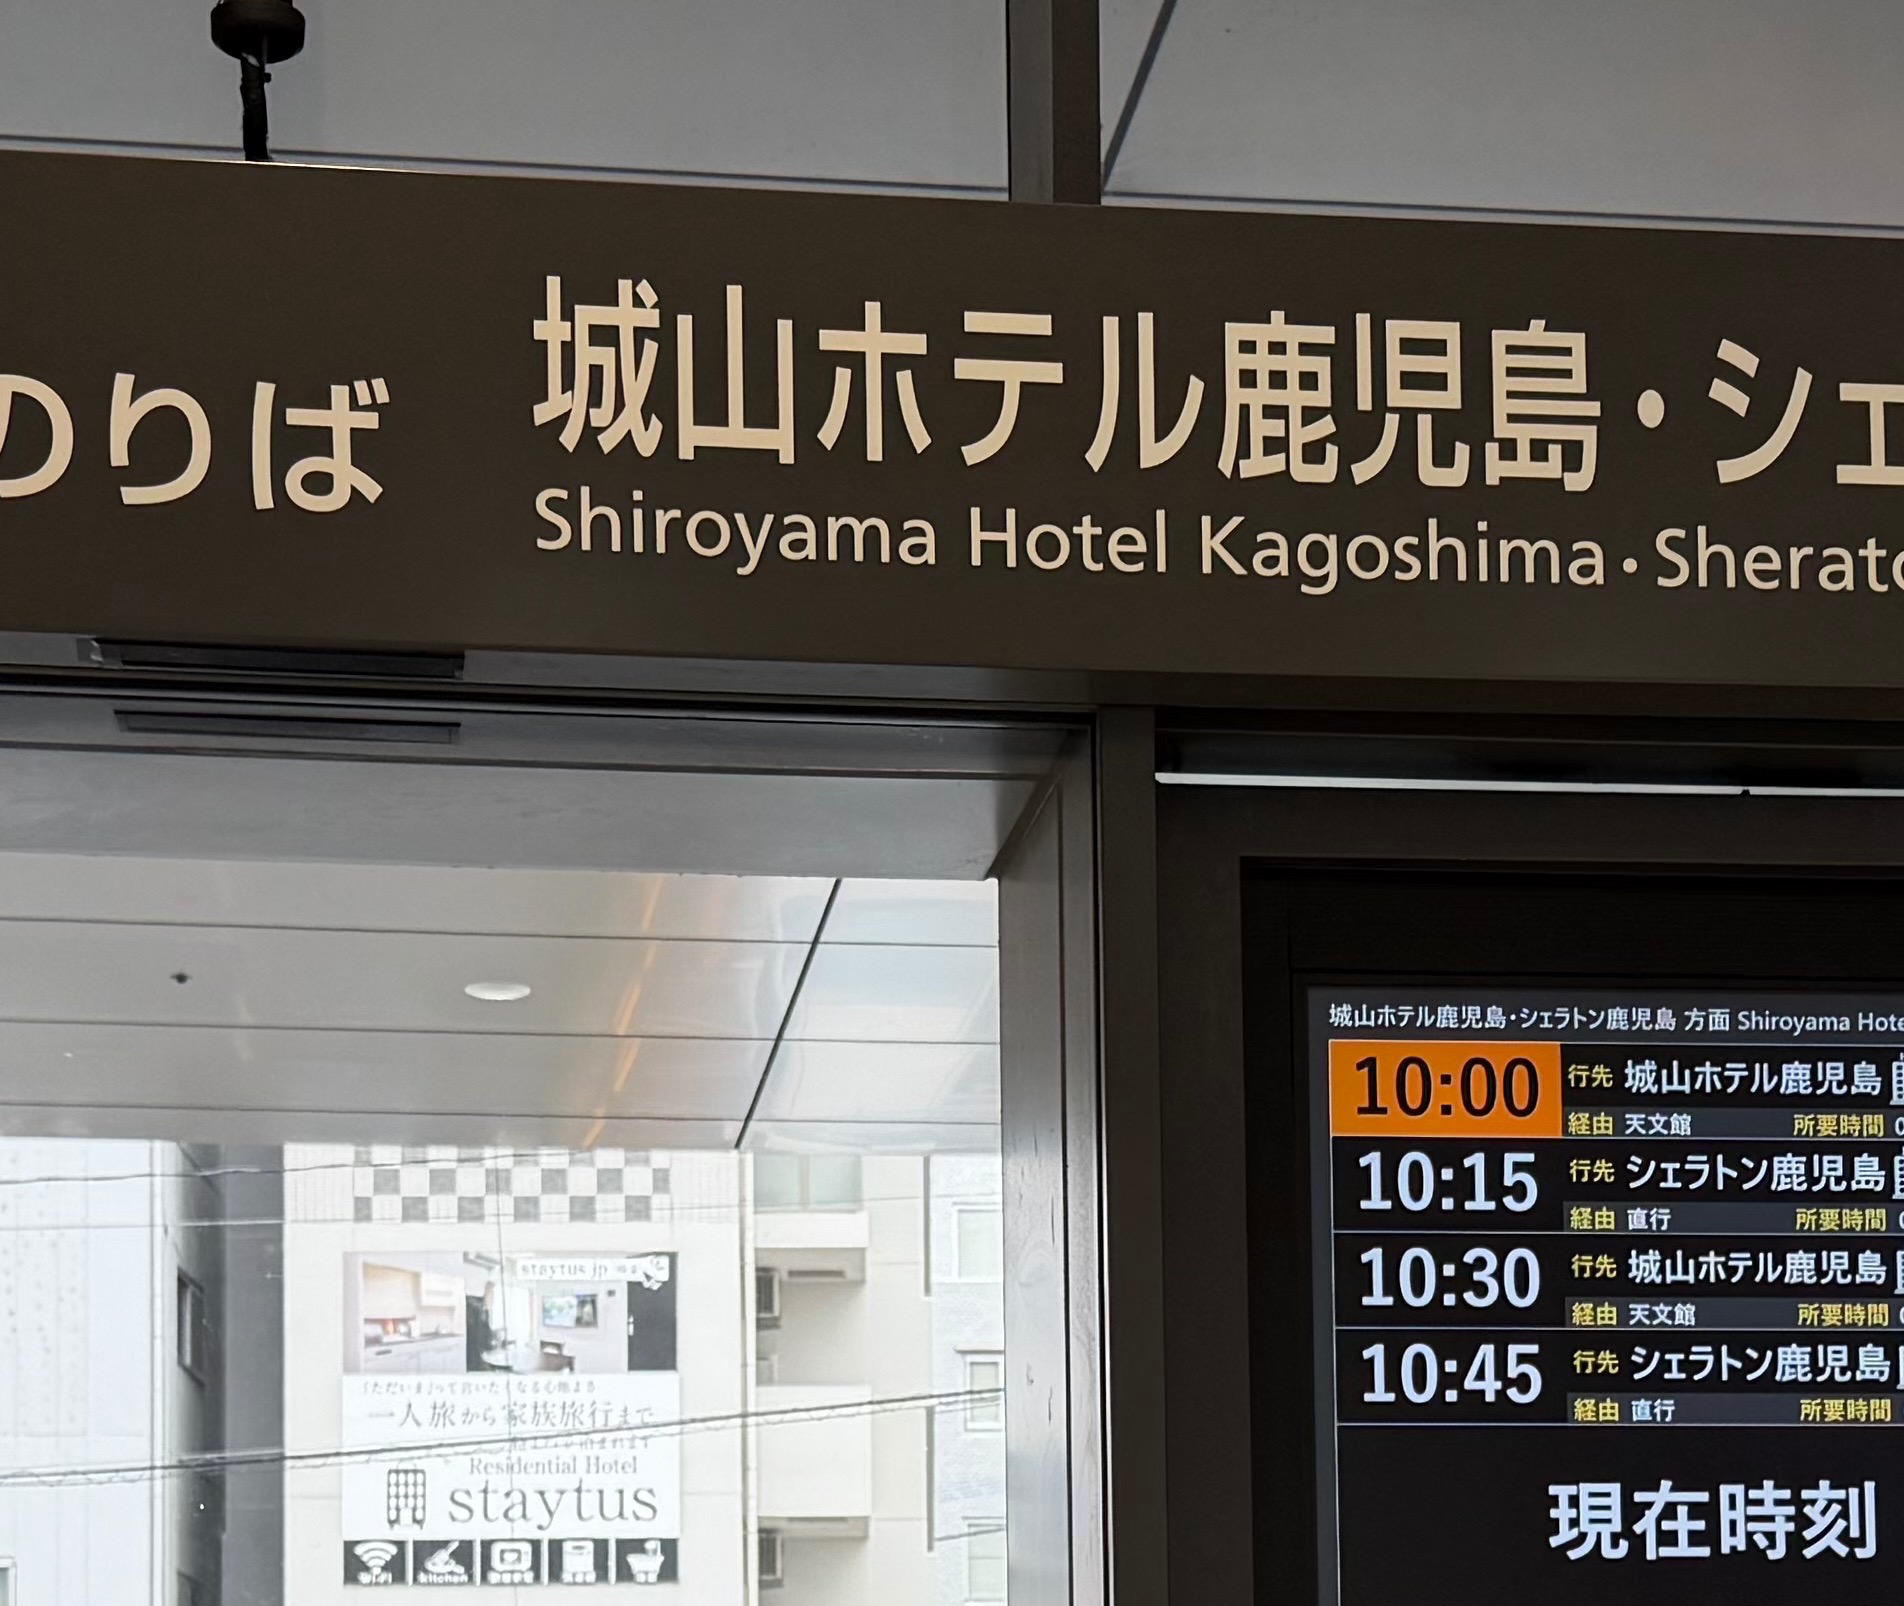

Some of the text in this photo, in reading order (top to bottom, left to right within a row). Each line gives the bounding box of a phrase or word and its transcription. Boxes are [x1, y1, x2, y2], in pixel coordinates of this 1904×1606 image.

[534, 488, 937, 576] Shiroyama
[970, 507, 1167, 574] Hotel
[1684, 1008, 1730, 1034] 方面
[1737, 1010, 1851, 1037] Shiroyama
[1353, 1055, 1541, 1117] 10:00
[1568, 1060, 1883, 1096] 行先 城山ホテル鹿児島
[1568, 1113, 1613, 1137] 経由
[1624, 1113, 1692, 1137] 天文館
[1793, 1113, 1885, 1138] 所要時間
[1358, 1151, 1539, 1211] 10:15
[1569, 1153, 1887, 1192] 行先 シェラトン鹿児島
[1570, 1207, 1615, 1231] 経由
[1627, 1207, 1672, 1232] 直行
[1795, 1207, 1887, 1232] 所要時間
[1359, 1246, 1542, 1307] 10:30
[1571, 1249, 1888, 1286] 行先 城山ホテル鹿児島
[1572, 1303, 1617, 1327] 経由
[1628, 1302, 1696, 1327] 天文館
[1797, 1302, 1889, 1327] 所要時間
[1360, 1343, 1544, 1404] 10:45
[1573, 1344, 1891, 1382] 行先 シェラトン鹿児島
[1574, 1398, 1620, 1422] 経由
[1631, 1399, 1676, 1423] 直行
[1799, 1398, 1892, 1423] 所要時間
[468, 1456, 639, 1476] Residential Hotel
[447, 1477, 659, 1531] staytus
[1546, 1479, 1879, 1563] 現在時刻
